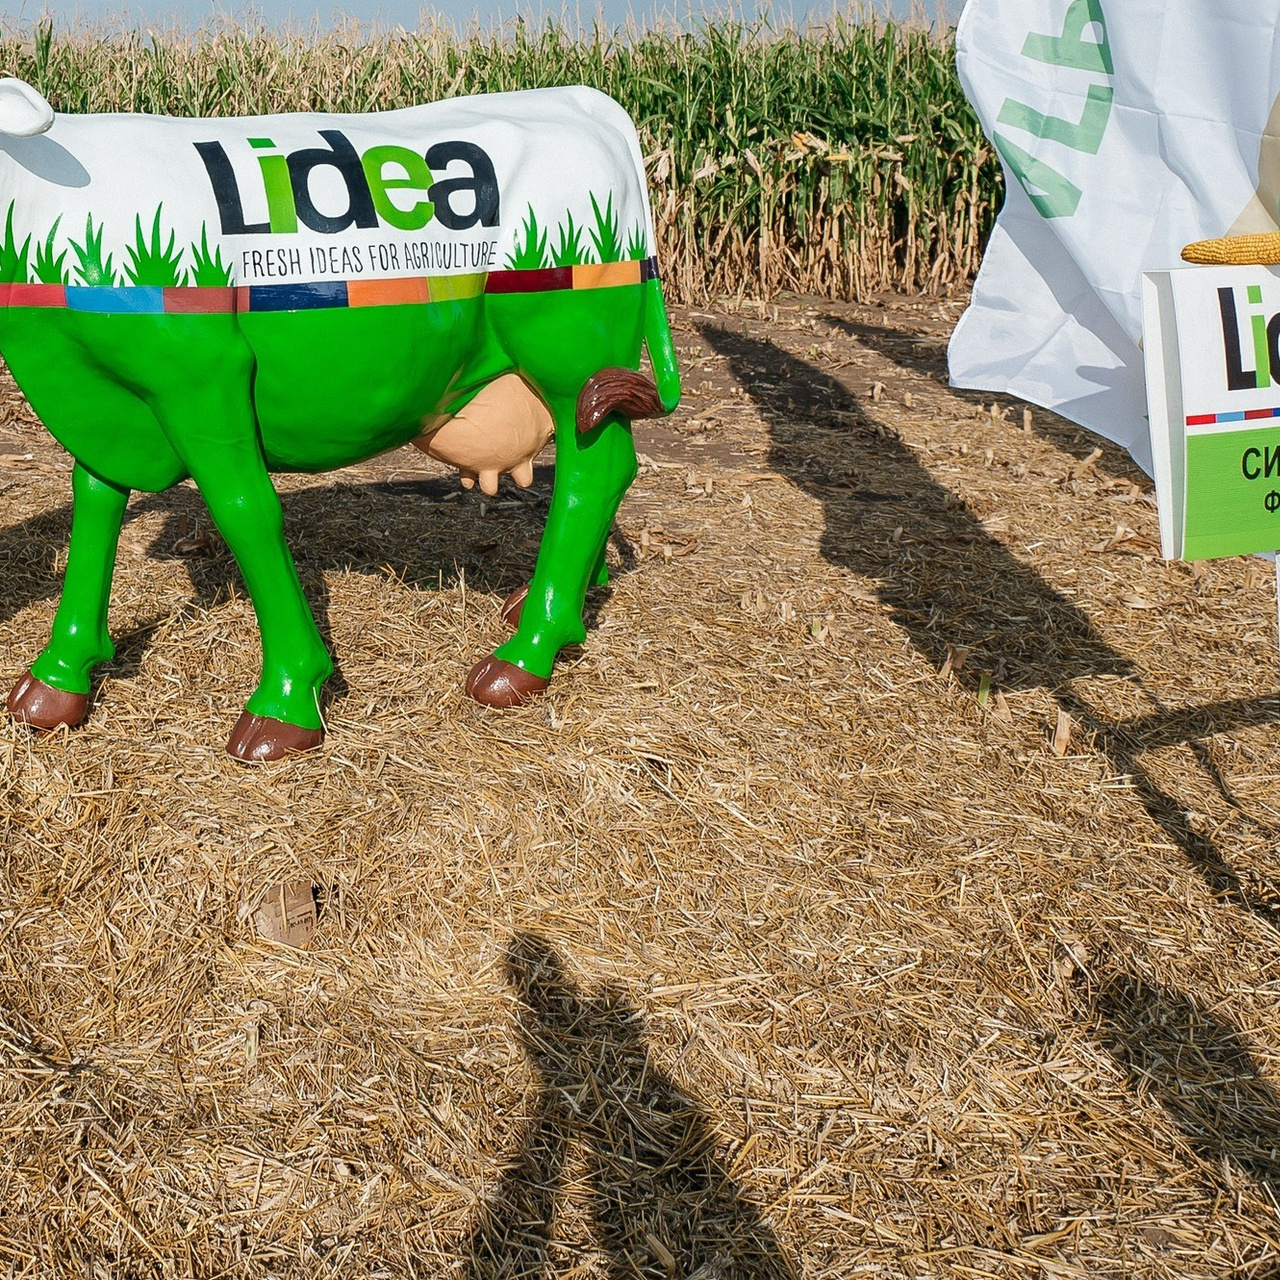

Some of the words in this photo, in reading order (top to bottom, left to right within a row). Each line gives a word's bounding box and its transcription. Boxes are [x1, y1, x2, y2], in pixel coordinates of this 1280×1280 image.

[192, 130, 500, 235] Lidea
[242, 248, 302, 278] FRESH
[310, 245, 364, 274] IDEAS
[369, 241, 400, 271] FOR
[404, 240, 498, 270] AGRICULTURE
